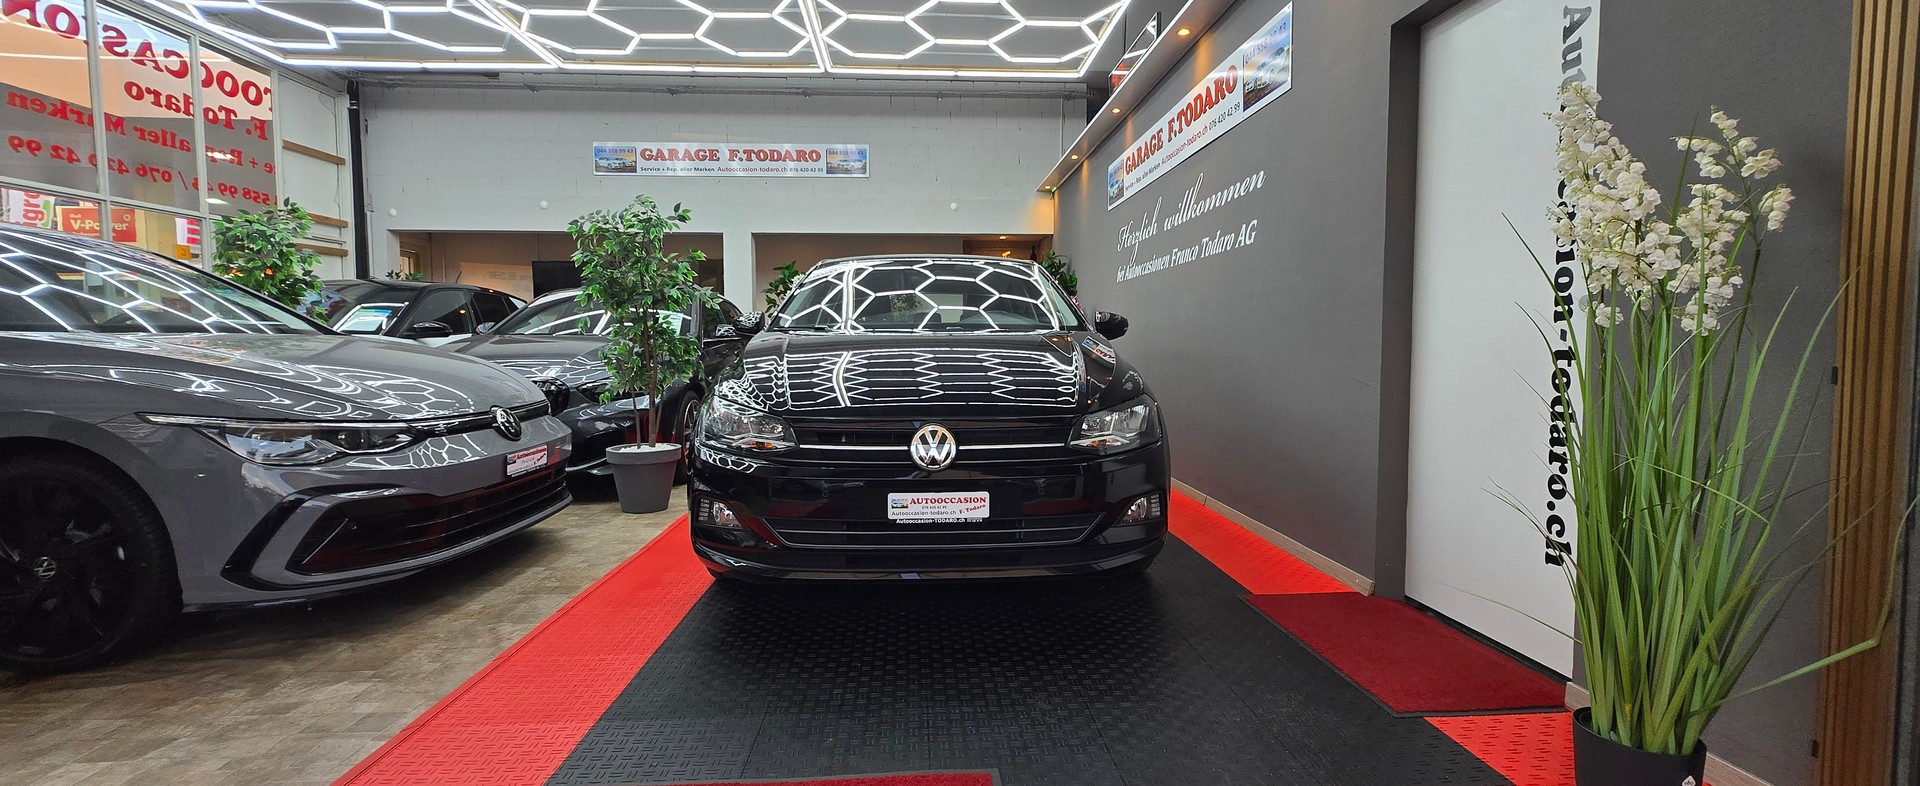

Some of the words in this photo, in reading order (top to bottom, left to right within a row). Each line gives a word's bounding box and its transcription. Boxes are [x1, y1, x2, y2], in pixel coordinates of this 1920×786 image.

[1125, 129, 1164, 176] GARAGE
[1167, 64, 1239, 143] F.TODARO
[1217, 112, 1226, 124] 420
[1227, 106, 1233, 117] 42
[1234, 101, 1241, 113] 99
[640, 148, 720, 162] GARAGE
[728, 149, 821, 162] F.TODARO
[1117, 196, 1162, 266] Herzlich
[1164, 172, 1267, 232] willkommen
[1116, 264, 1126, 283] bei
[1171, 245, 1199, 267] Franco
[1200, 230, 1235, 258] Todaro
[1235, 219, 1258, 248] AG
[910, 424, 956, 471] VW
[909, 496, 987, 505] AUTOOCCASION
[965, 504, 986, 513] Todaro
